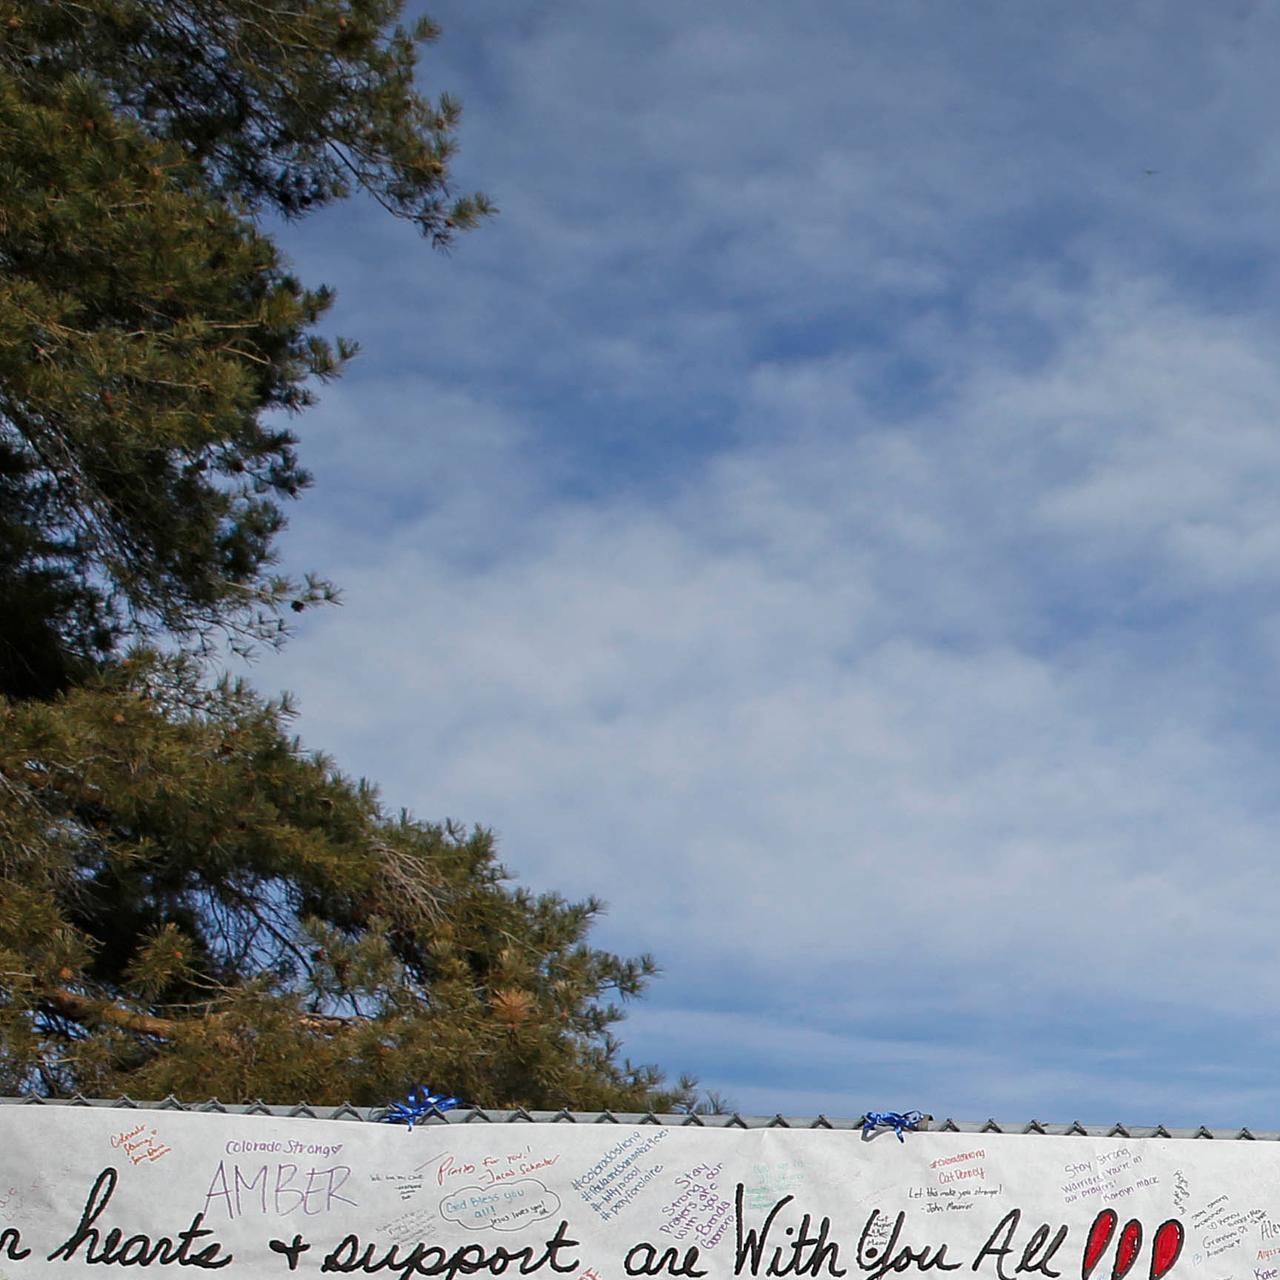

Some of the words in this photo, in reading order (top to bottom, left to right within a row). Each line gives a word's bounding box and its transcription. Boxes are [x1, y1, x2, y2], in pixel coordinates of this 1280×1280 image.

[204, 1159, 358, 1220] AMBER
[624, 1242, 709, 1277] are
[734, 1182, 847, 1279] With
[1253, 1267, 1279, 1280] Kate
